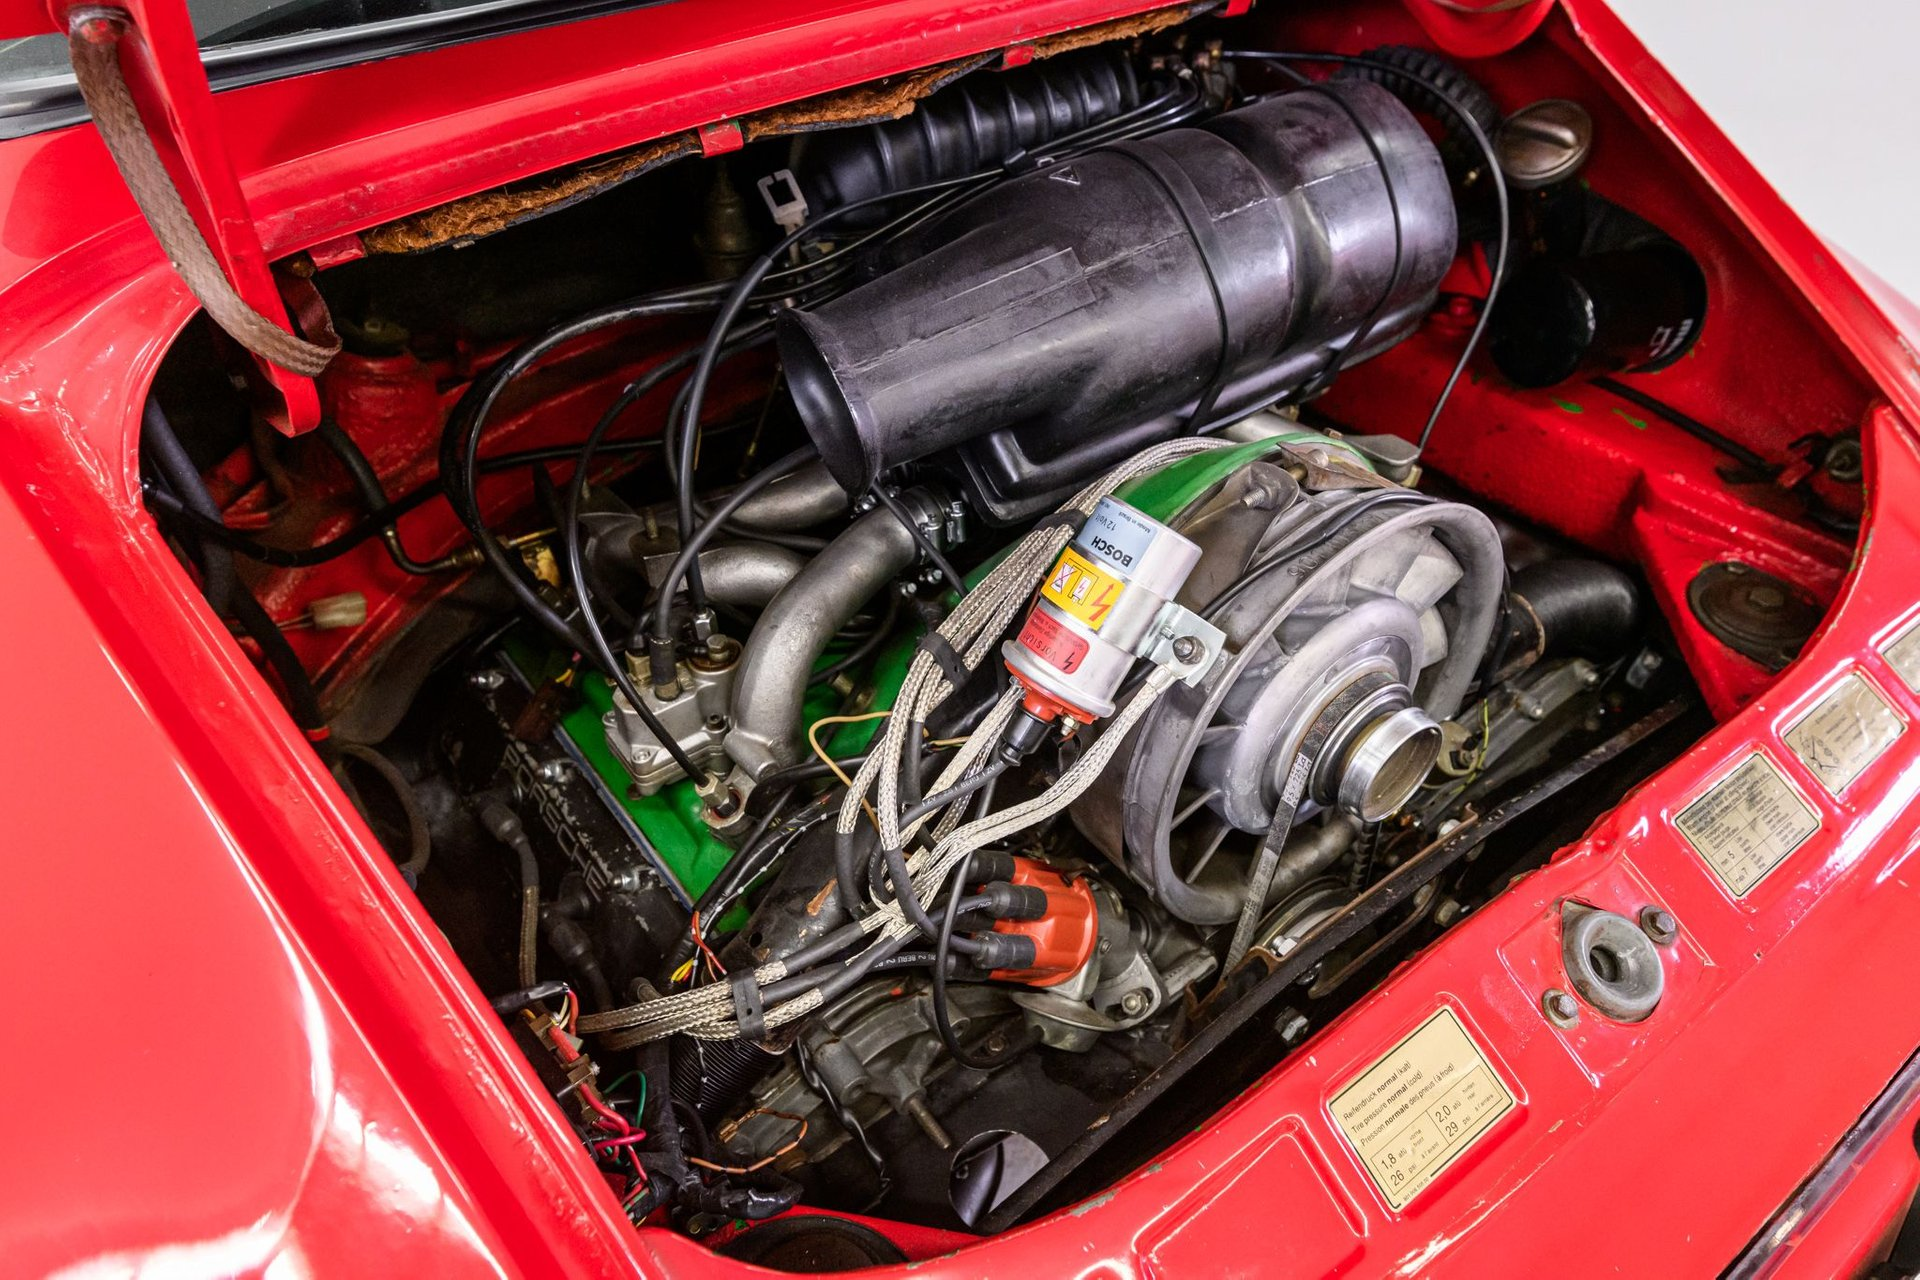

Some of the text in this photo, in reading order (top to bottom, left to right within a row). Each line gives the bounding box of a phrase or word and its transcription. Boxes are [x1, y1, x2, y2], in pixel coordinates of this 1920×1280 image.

[1105, 519, 1117, 531] 12
[1090, 535, 1133, 567] BOSCH
[501, 743, 609, 905] PORSCHE
[1726, 849, 1735, 860] 5
[897, 954, 916, 962] BERU
[1342, 1060, 1412, 1121] Reifendruck normal (kalt)
[1350, 1069, 1424, 1134] Tire pressure normal (cold)
[1359, 1122, 1385, 1146] Pression
[1382, 1101, 1410, 1126] normale
[1406, 1092, 1420, 1105] des
[1417, 1079, 1436, 1098] pneus
[1433, 1104, 1453, 1124] 2,0
[1443, 1120, 1460, 1137] 29
[1460, 1114, 1472, 1125] psi
[1381, 1151, 1398, 1172] 1,8
[1389, 1168, 1405, 1187] 26
[1407, 1162, 1418, 1173] psi
